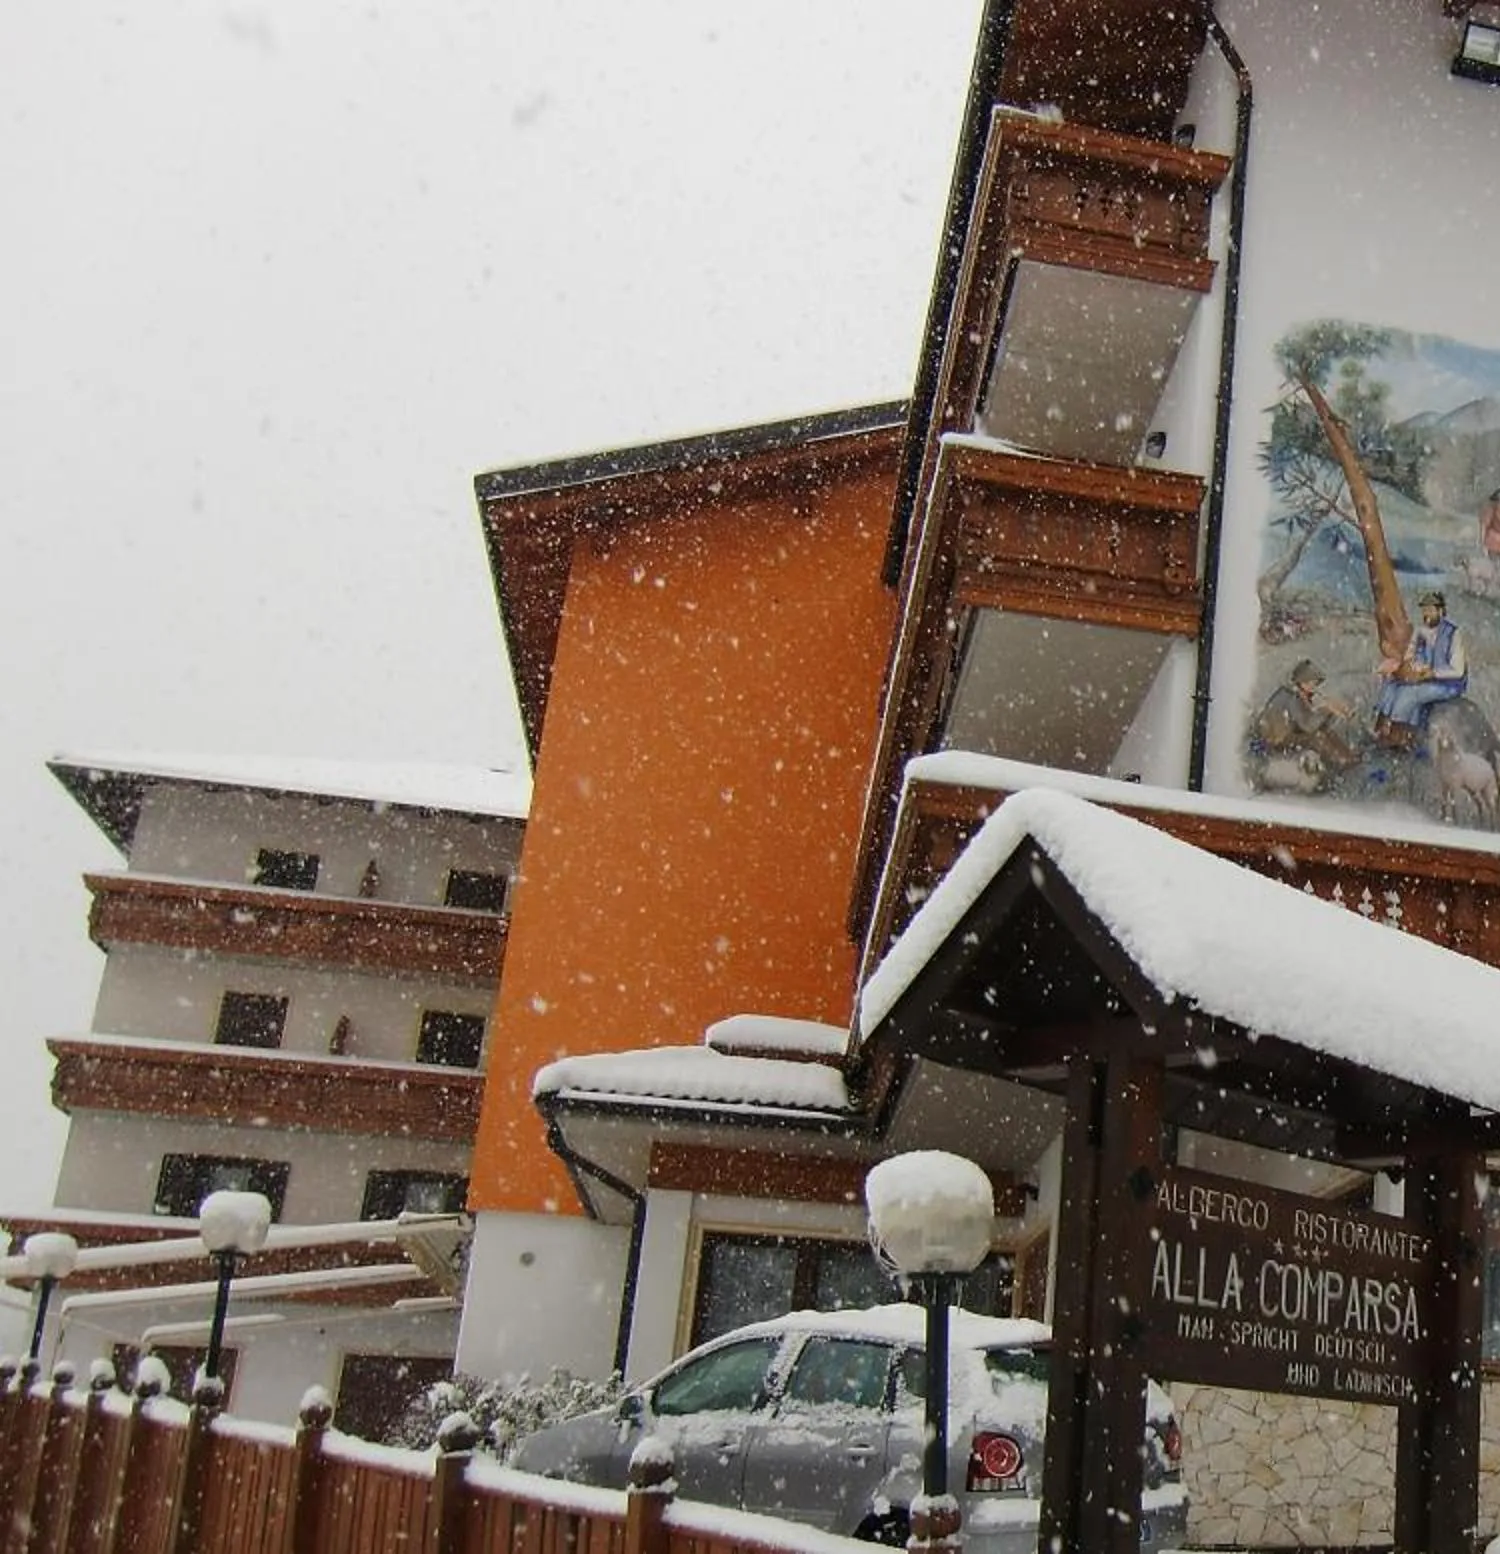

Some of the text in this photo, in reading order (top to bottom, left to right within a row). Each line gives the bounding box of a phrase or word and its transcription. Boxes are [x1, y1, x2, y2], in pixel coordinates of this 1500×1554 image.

[1294, 1209, 1421, 1262] RISTORANTE
[1152, 1239, 1420, 1340] ALLA COMPARSA
[1231, 1320, 1298, 1353] SPRICHT
